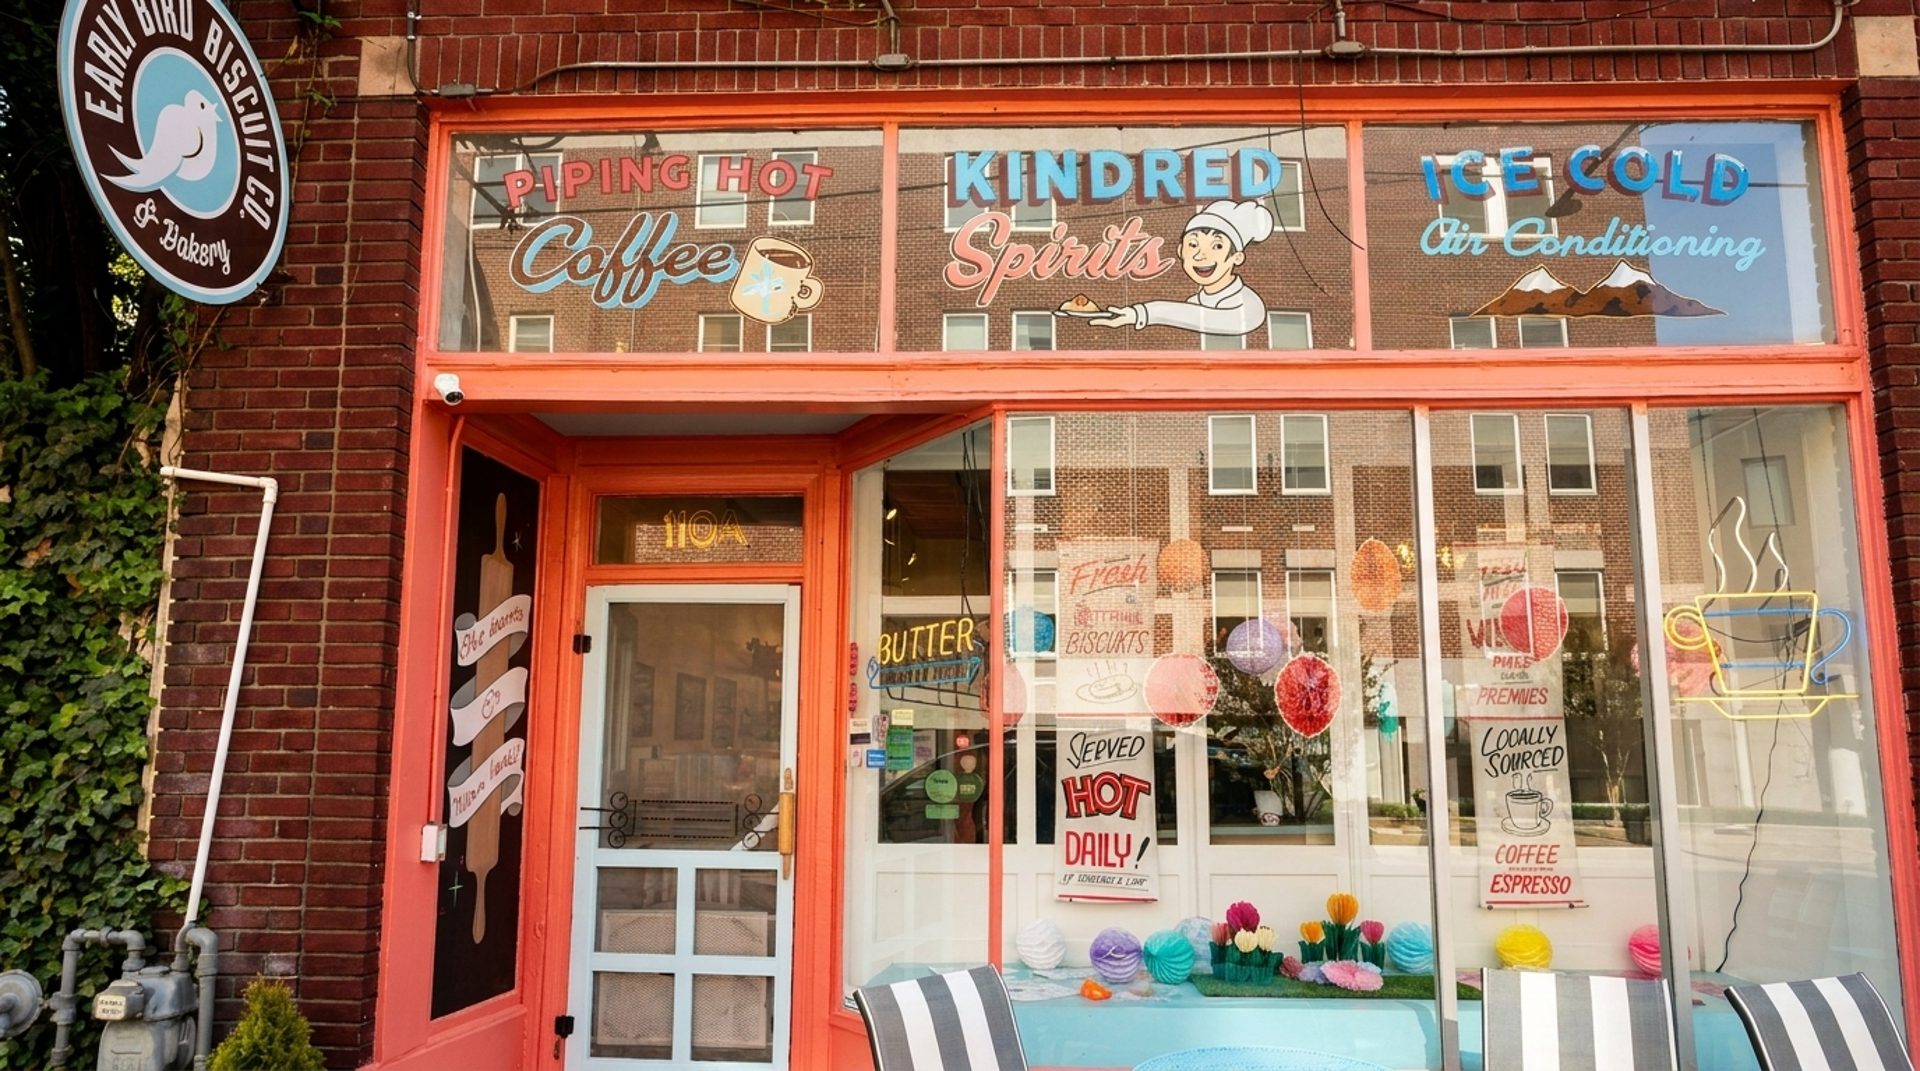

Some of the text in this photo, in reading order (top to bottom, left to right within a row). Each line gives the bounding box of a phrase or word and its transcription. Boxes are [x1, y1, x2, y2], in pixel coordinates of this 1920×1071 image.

[85, 0, 275, 230] EARLY BIRD BISCUIT CO.
[503, 155, 834, 209] PIPING HOT
[948, 147, 1282, 208] KINDRED
[1420, 144, 1750, 207] ICE COLD
[159, 218, 231, 275] Bakery
[509, 211, 740, 309] Coffee
[943, 211, 1176, 308] Spirits
[1419, 216, 1766, 272] Air Conditioning
[878, 617, 975, 665] BUTTER
[1062, 771, 1151, 820] HOT
[1495, 844, 1560, 865] COFFEE
[1490, 874, 1571, 895] ESPRESSO
